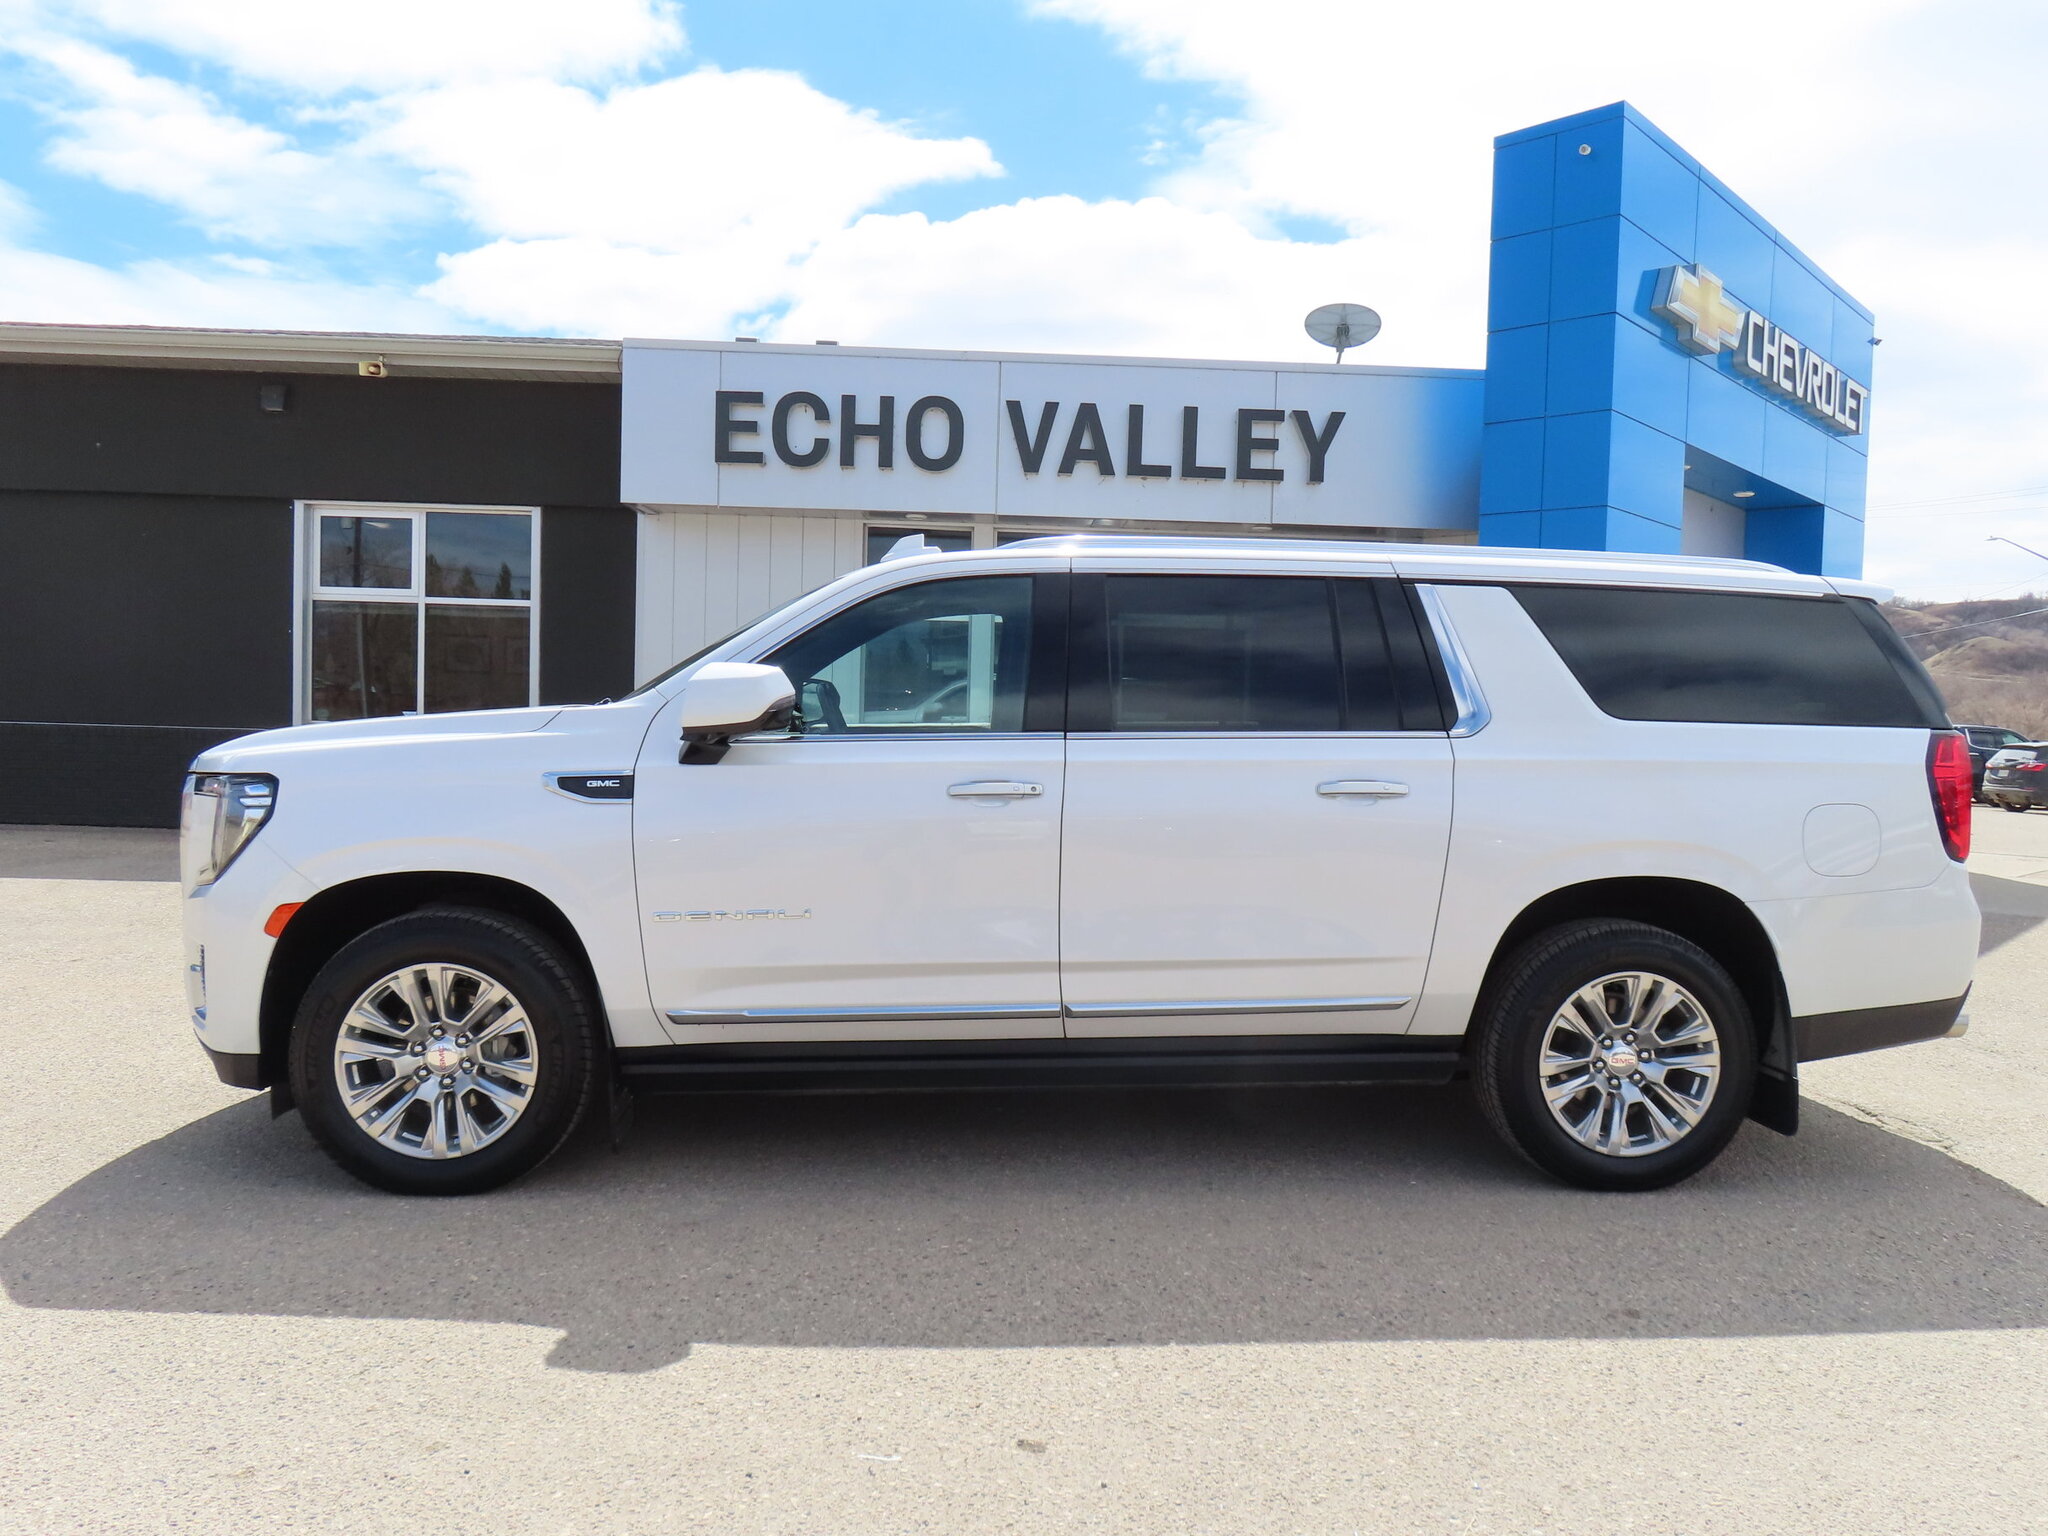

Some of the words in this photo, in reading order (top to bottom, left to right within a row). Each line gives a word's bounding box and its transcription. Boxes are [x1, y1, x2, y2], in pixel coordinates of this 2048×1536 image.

[1746, 310, 1870, 434] CHEVROLET
[714, 390, 965, 472] ECHO
[1006, 401, 1346, 485] VALLEY
[652, 908, 812, 922] DENALI
[438, 1045, 447, 1070] GMC
